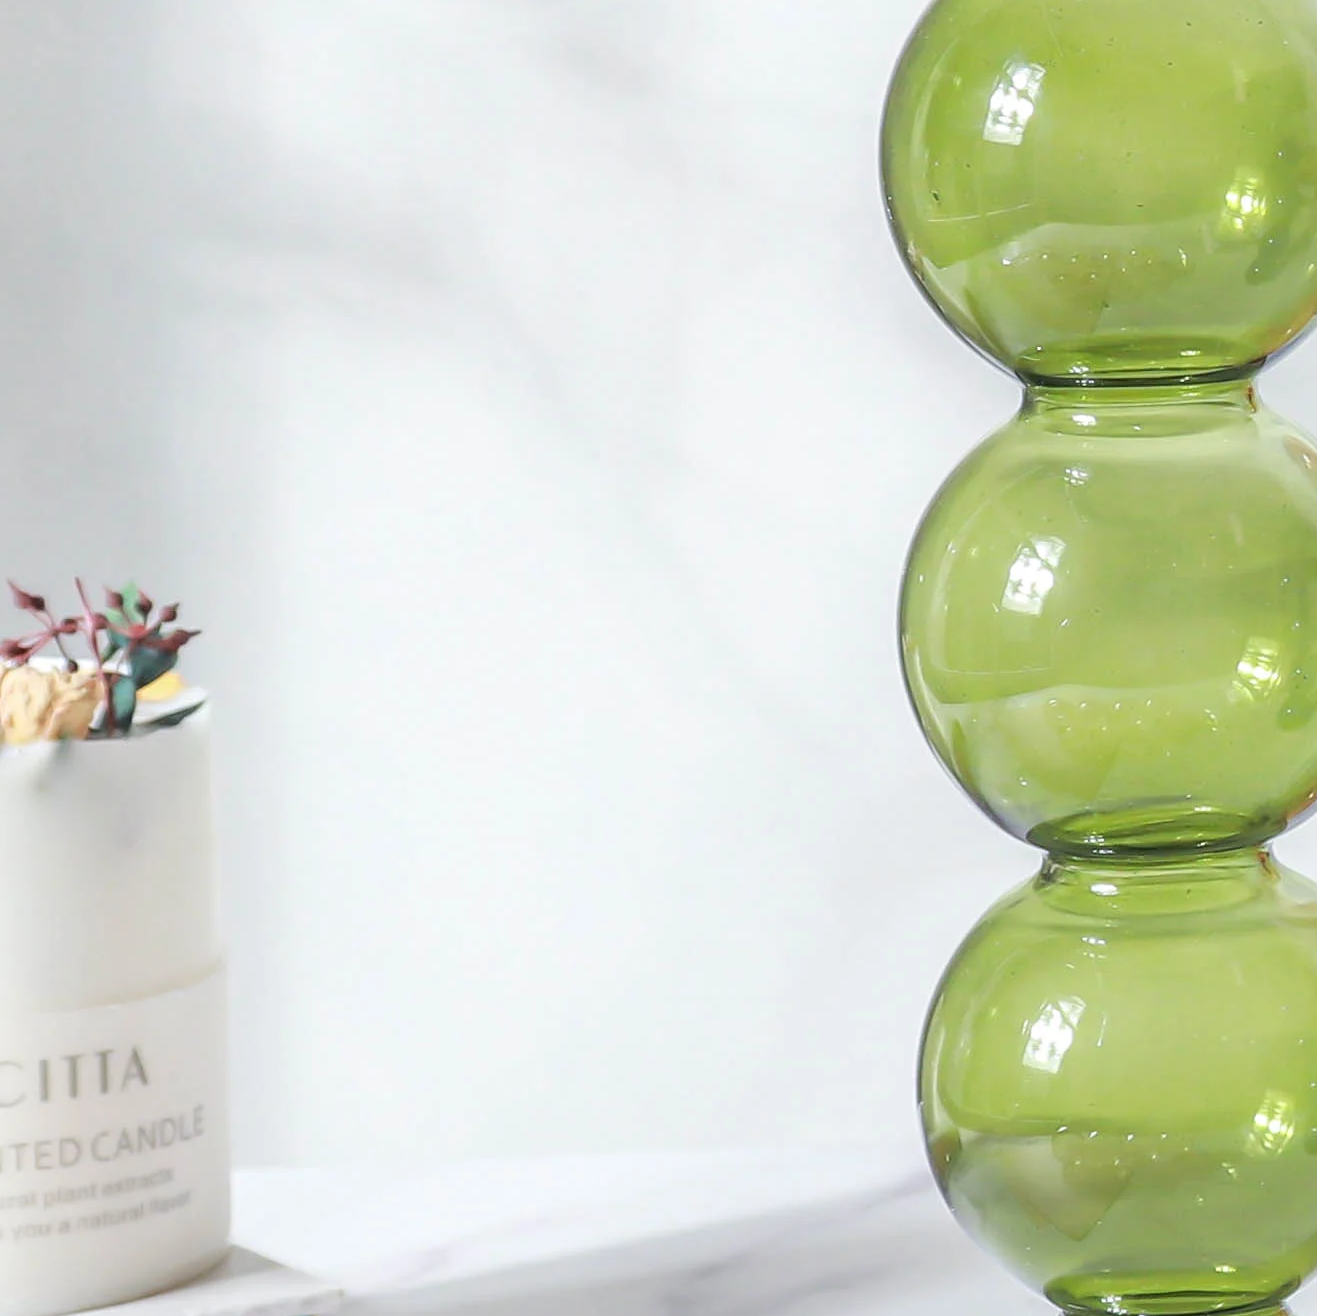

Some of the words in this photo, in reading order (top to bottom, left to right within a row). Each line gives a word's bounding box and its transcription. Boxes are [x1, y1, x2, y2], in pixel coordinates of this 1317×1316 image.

[0, 1138, 81, 1173] TED
[90, 1104, 205, 1162] CANDLE
[43, 1183, 97, 1209] plant
[11, 1220, 52, 1242] you
[57, 1218, 71, 1233] a
[77, 1202, 144, 1230] natural
